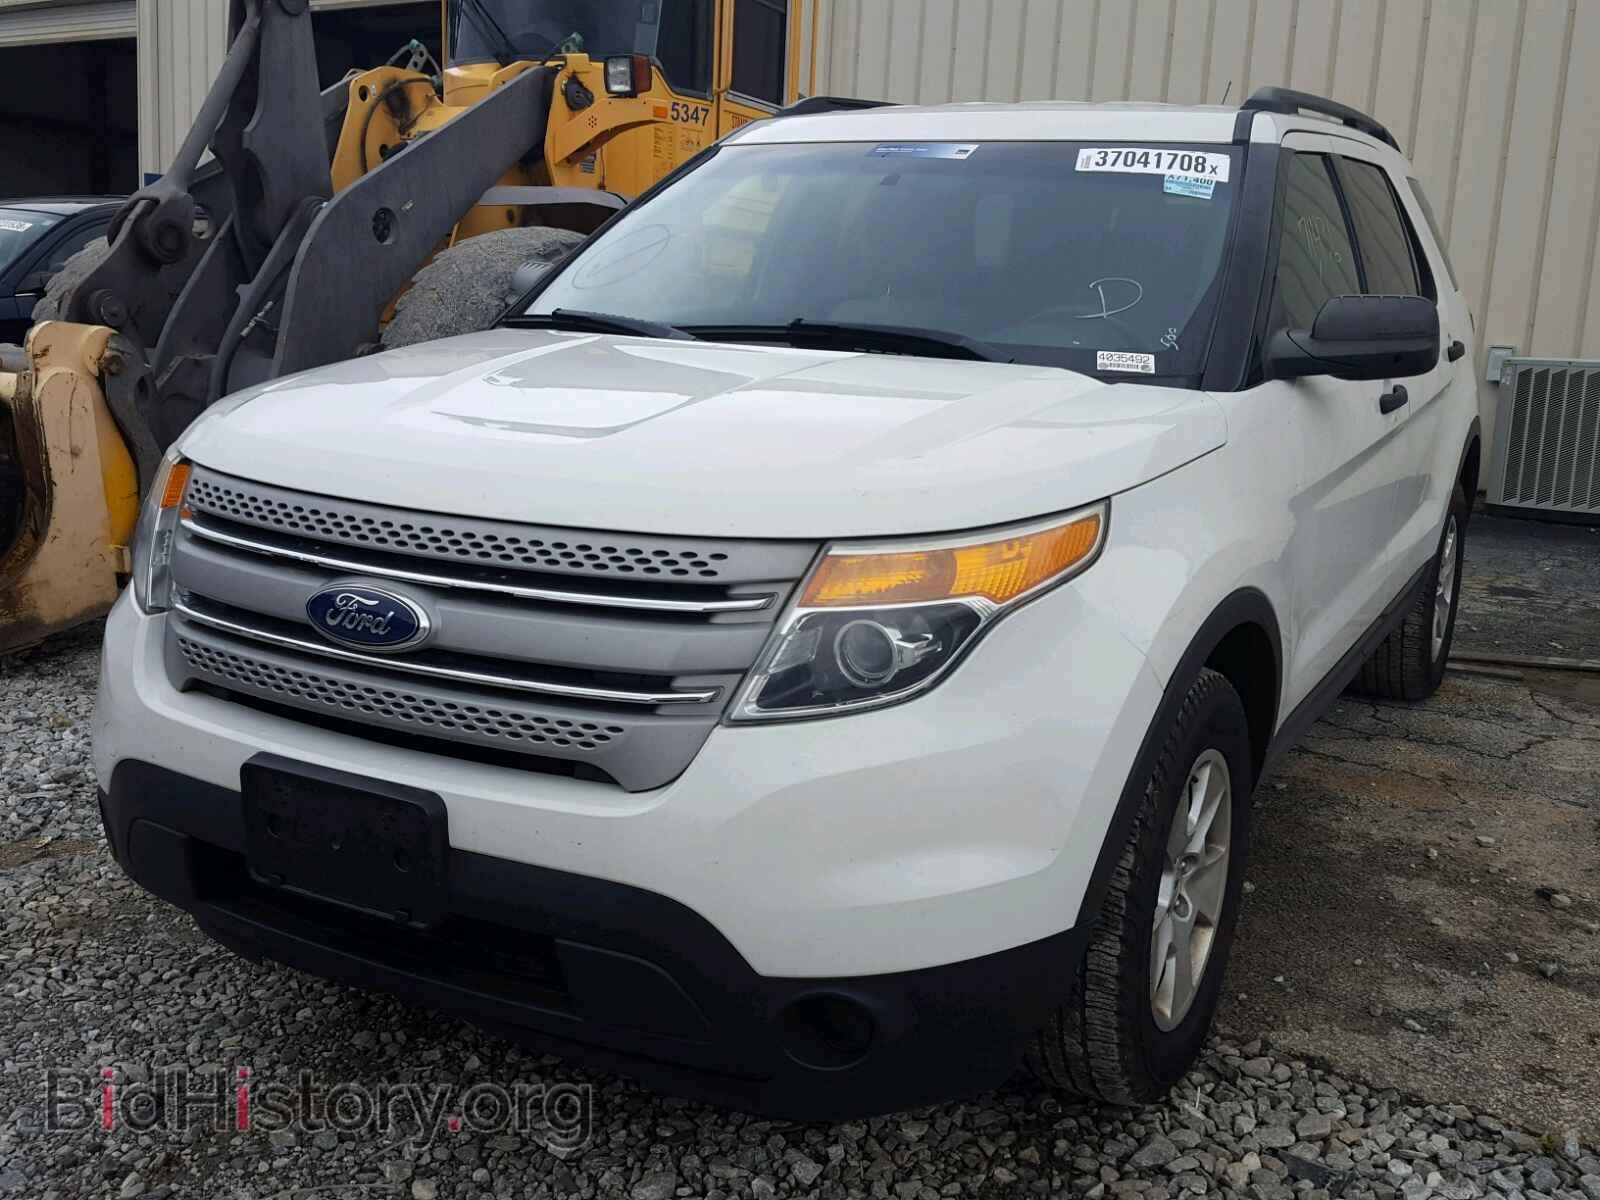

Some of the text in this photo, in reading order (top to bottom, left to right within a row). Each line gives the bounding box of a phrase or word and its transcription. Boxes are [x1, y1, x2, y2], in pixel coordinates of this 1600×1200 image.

[671, 101, 709, 127] 5347
[1098, 352, 1150, 365] 4035492
[326, 592, 394, 635] Ford
